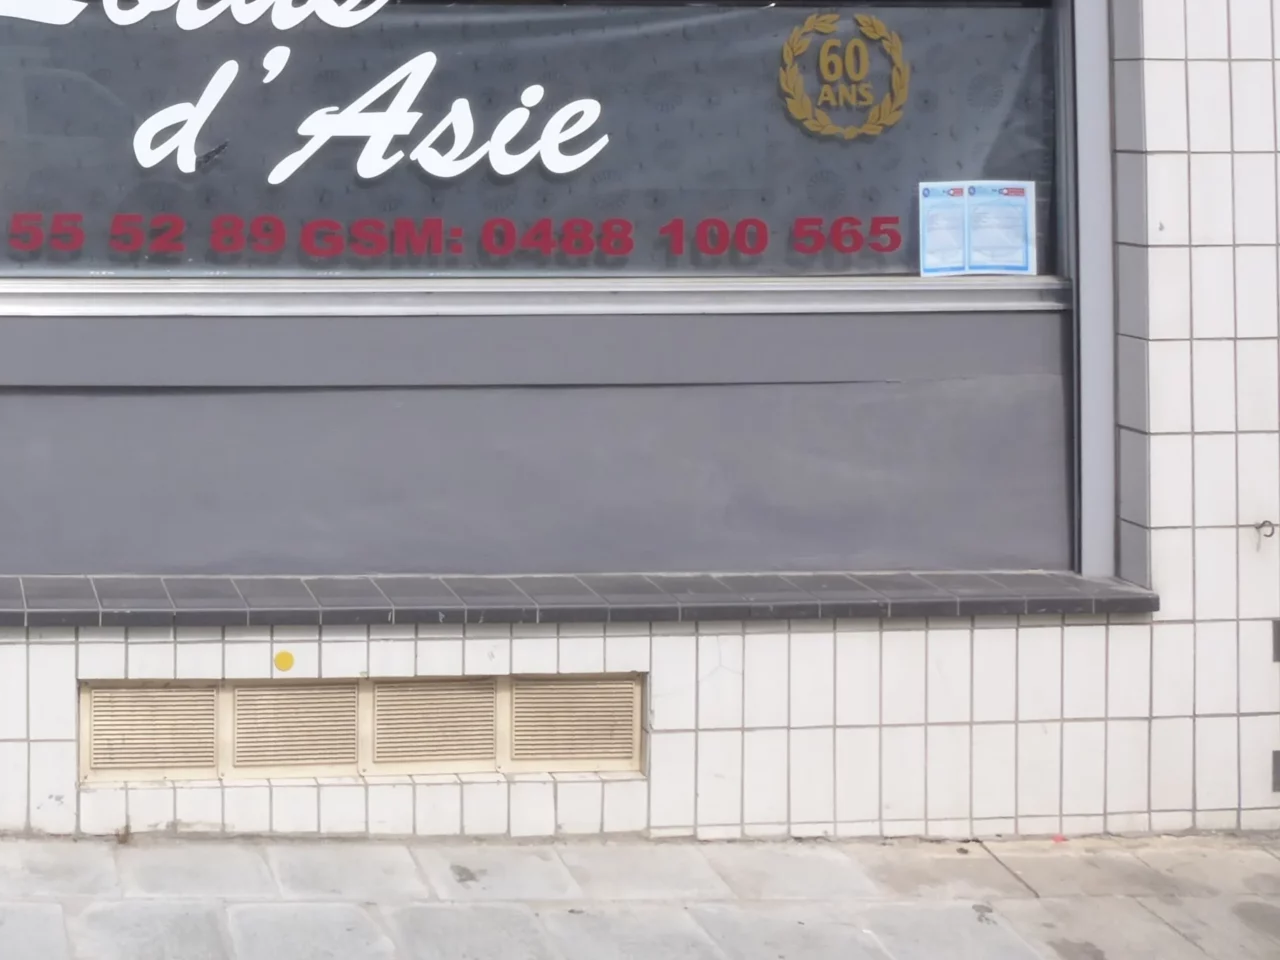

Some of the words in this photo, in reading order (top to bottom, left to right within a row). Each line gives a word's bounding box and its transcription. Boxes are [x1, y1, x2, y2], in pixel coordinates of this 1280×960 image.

[820, 38, 869, 82] 60
[133, 46, 609, 184] d'Asie
[817, 83, 873, 107] ANS
[8, 213, 86, 252] 55
[110, 213, 185, 252] 52
[211, 214, 286, 254] 89
[300, 218, 463, 257] GSM:
[481, 218, 634, 256] 0488
[658, 218, 768, 256] 100
[791, 216, 902, 254] 565
